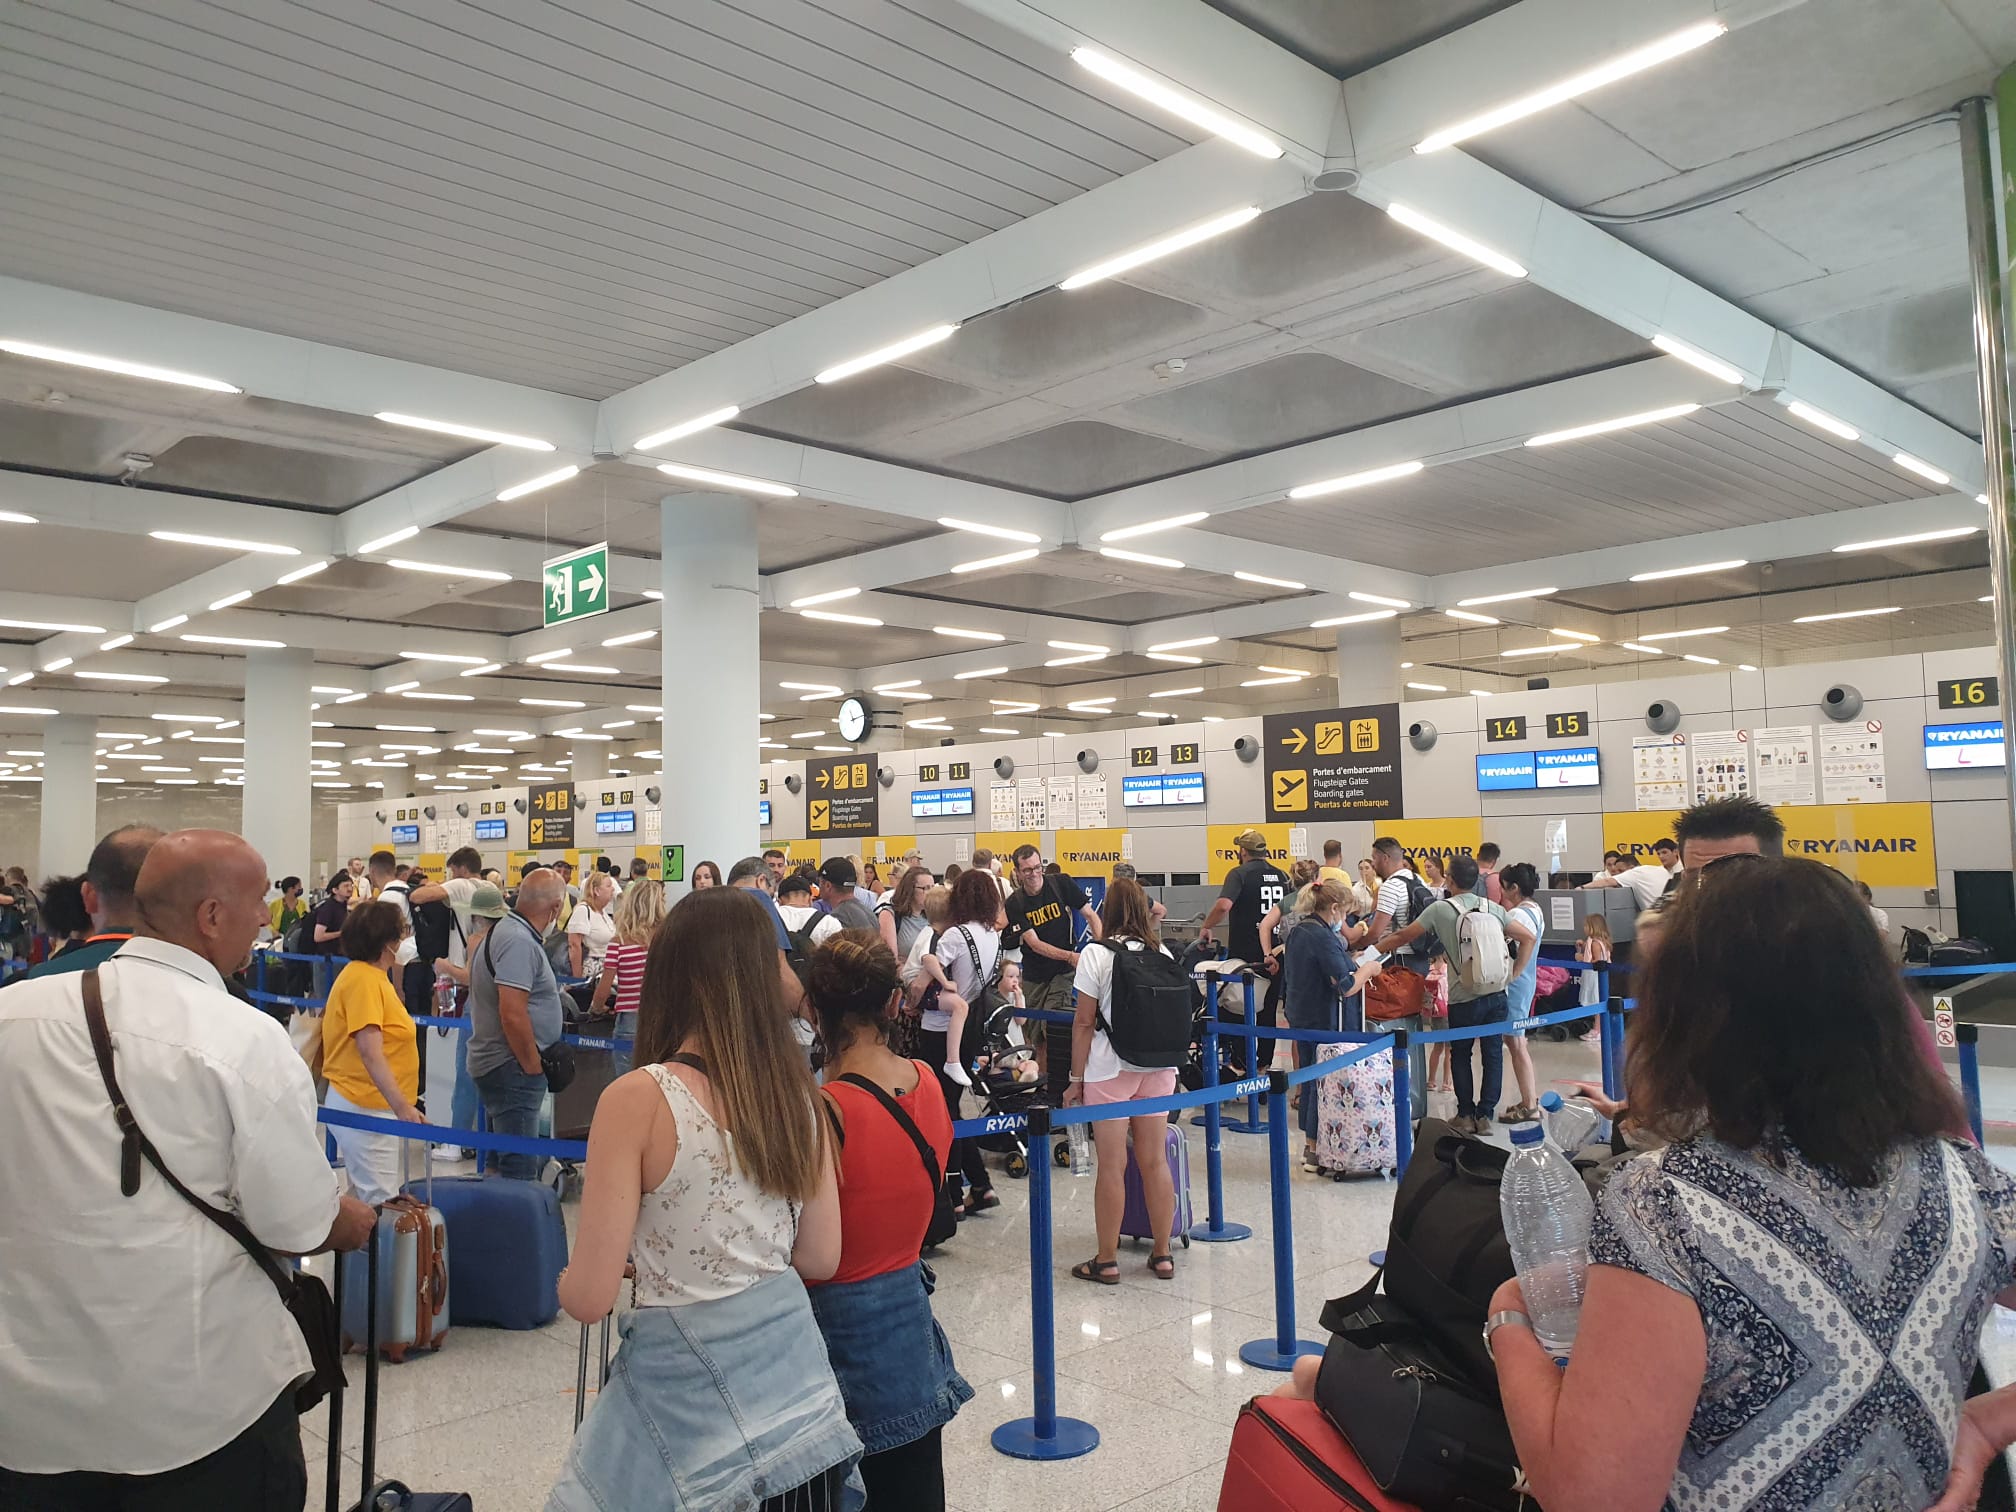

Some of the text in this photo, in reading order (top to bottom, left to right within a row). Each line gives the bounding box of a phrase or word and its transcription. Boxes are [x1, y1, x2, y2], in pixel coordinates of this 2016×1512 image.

[1950, 682, 1985, 705] 16
[1494, 720, 1517, 739] 14
[1555, 715, 1579, 735] 15
[1136, 749, 1152, 764] 12
[1176, 746, 1192, 761] 13
[1545, 753, 1596, 764] RYANAIR
[923, 767, 935, 780] 10
[953, 765, 965, 778] 11
[1313, 764, 1392, 776] Portes d'embarcament
[1487, 766, 1533, 776] RYANAIR
[760, 781, 765, 792] 9
[1129, 780, 1161, 788] RYANAIR
[1168, 777, 1202, 786] RYANAIR
[1313, 777, 1369, 788] Flugsteige Gates
[622, 793, 631, 802] 07
[1313, 788, 1364, 798] Boarding gates
[1314, 799, 1389, 809] Puertas de embarque
[1804, 839, 1917, 853] RYANAIR
[1070, 852, 1120, 862] RYANAIR
[1260, 886, 1284, 914] 99
[1025, 902, 1062, 926] TOKYO
[986, 1114, 1028, 1132] RYAN
